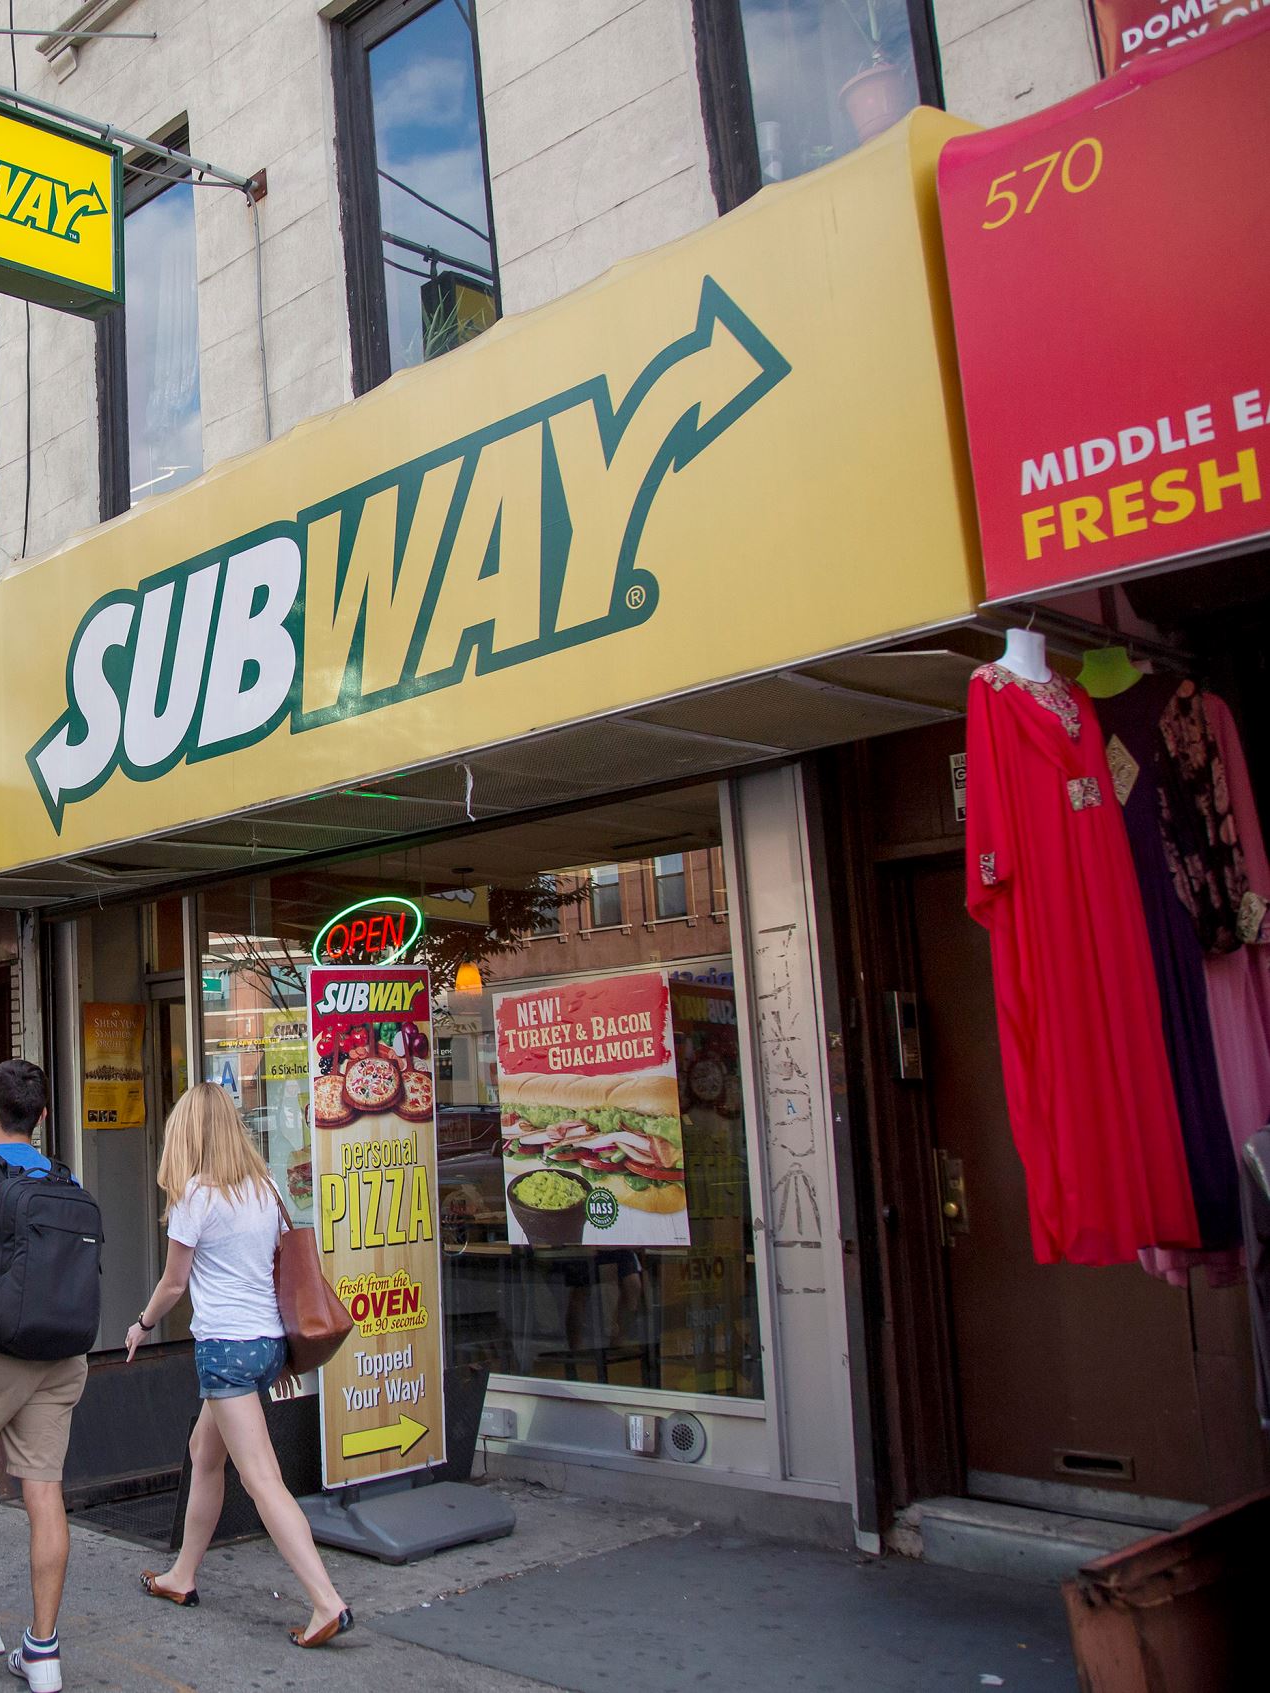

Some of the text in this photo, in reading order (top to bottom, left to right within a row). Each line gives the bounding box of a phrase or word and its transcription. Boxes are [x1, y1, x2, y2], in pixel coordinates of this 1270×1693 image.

[981, 137, 1103, 231] 570
[1020, 404, 1215, 496] MIDDLE
[1021, 447, 1262, 560] FRESH
[25, 275, 791, 836] SUBWAY
[326, 912, 406, 960] OPEN
[315, 977, 425, 1018] SUBWAY
[516, 997, 562, 1028] NEW!
[94, 1018, 118, 1028] SHEN
[504, 1011, 652, 1053] TURKEY & BACON
[271, 1065, 276, 1075] 6
[548, 1036, 655, 1070] GUACAMOLE
[221, 1061, 237, 1092] A
[341, 1131, 417, 1177] personal
[320, 1165, 433, 1254] PIZZA
[590, 1202, 613, 1215] HASS
[338, 1275, 408, 1298] fresh from the
[351, 1286, 420, 1321] OVEN
[362, 1313, 426, 1334] in 90 seconds
[354, 1344, 413, 1379] Topped
[342, 1374, 426, 1411] Your Way!
